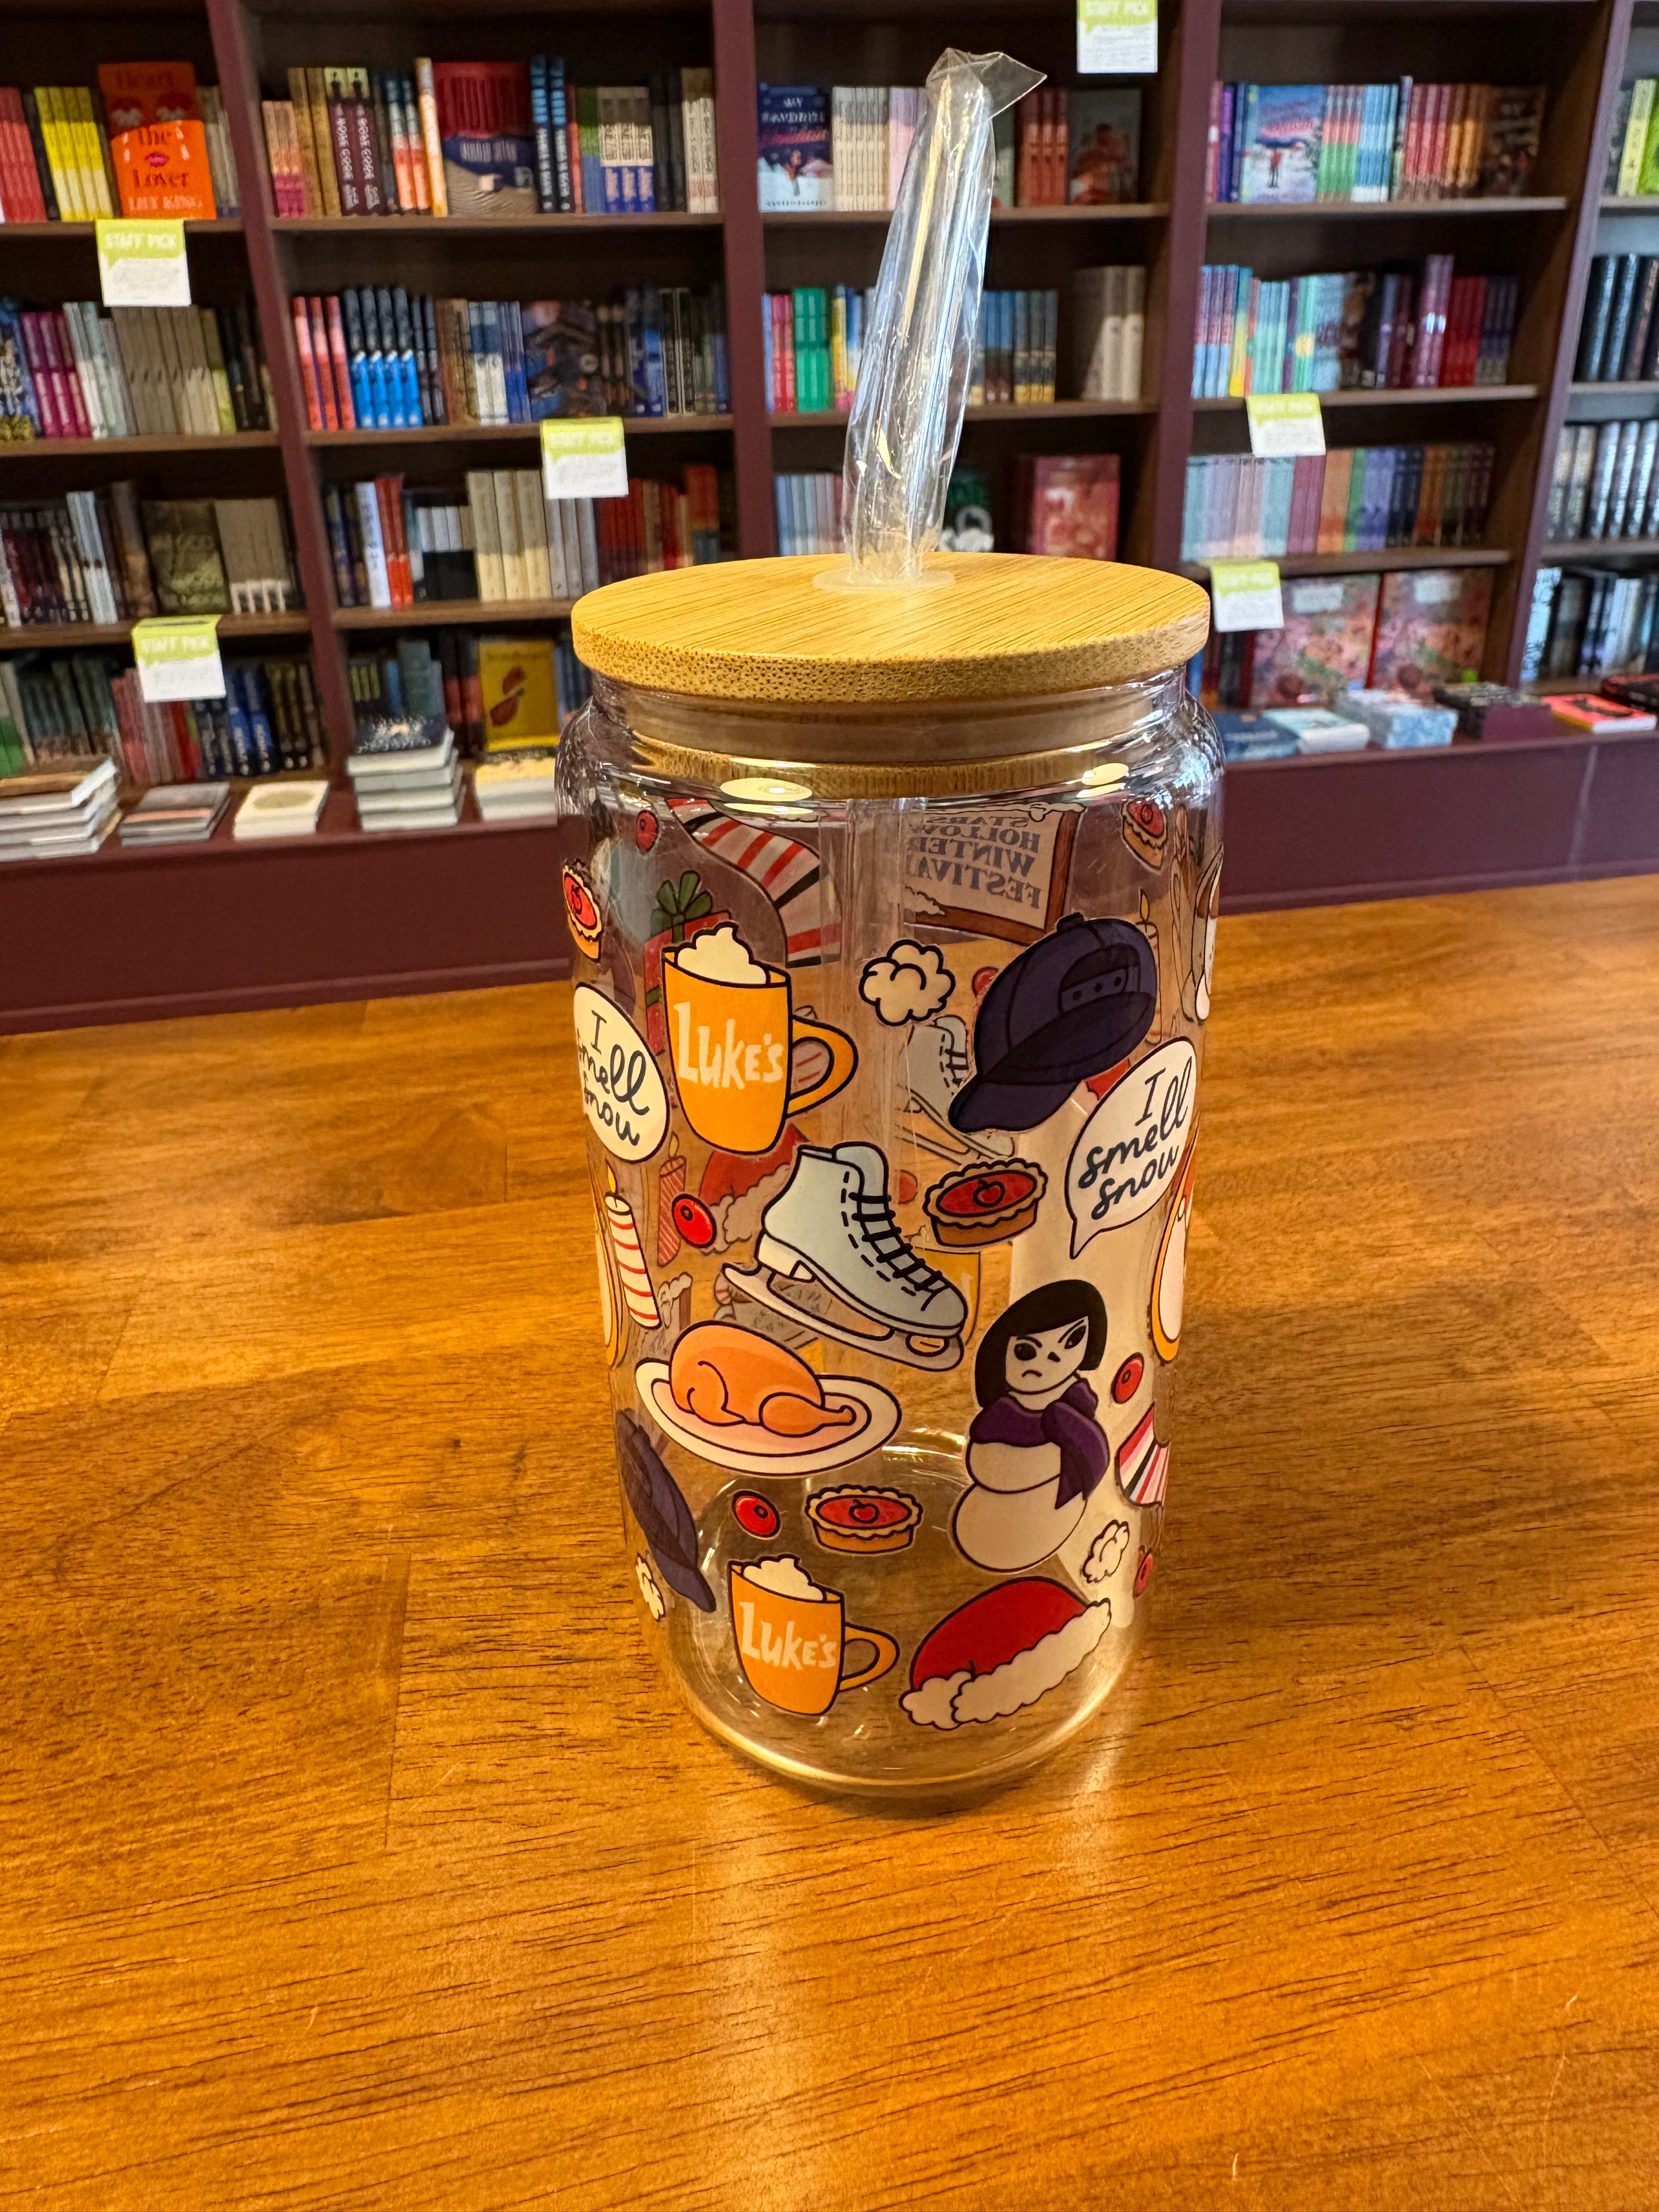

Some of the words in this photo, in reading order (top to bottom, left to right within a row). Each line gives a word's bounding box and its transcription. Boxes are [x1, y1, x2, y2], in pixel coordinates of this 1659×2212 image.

[133, 170, 189, 188] Lover
[591, 1009, 607, 1055] I
[1077, 1056, 1193, 1189] smell
[1135, 1067, 1166, 1127] I
[1091, 1144, 1180, 1221] snow
